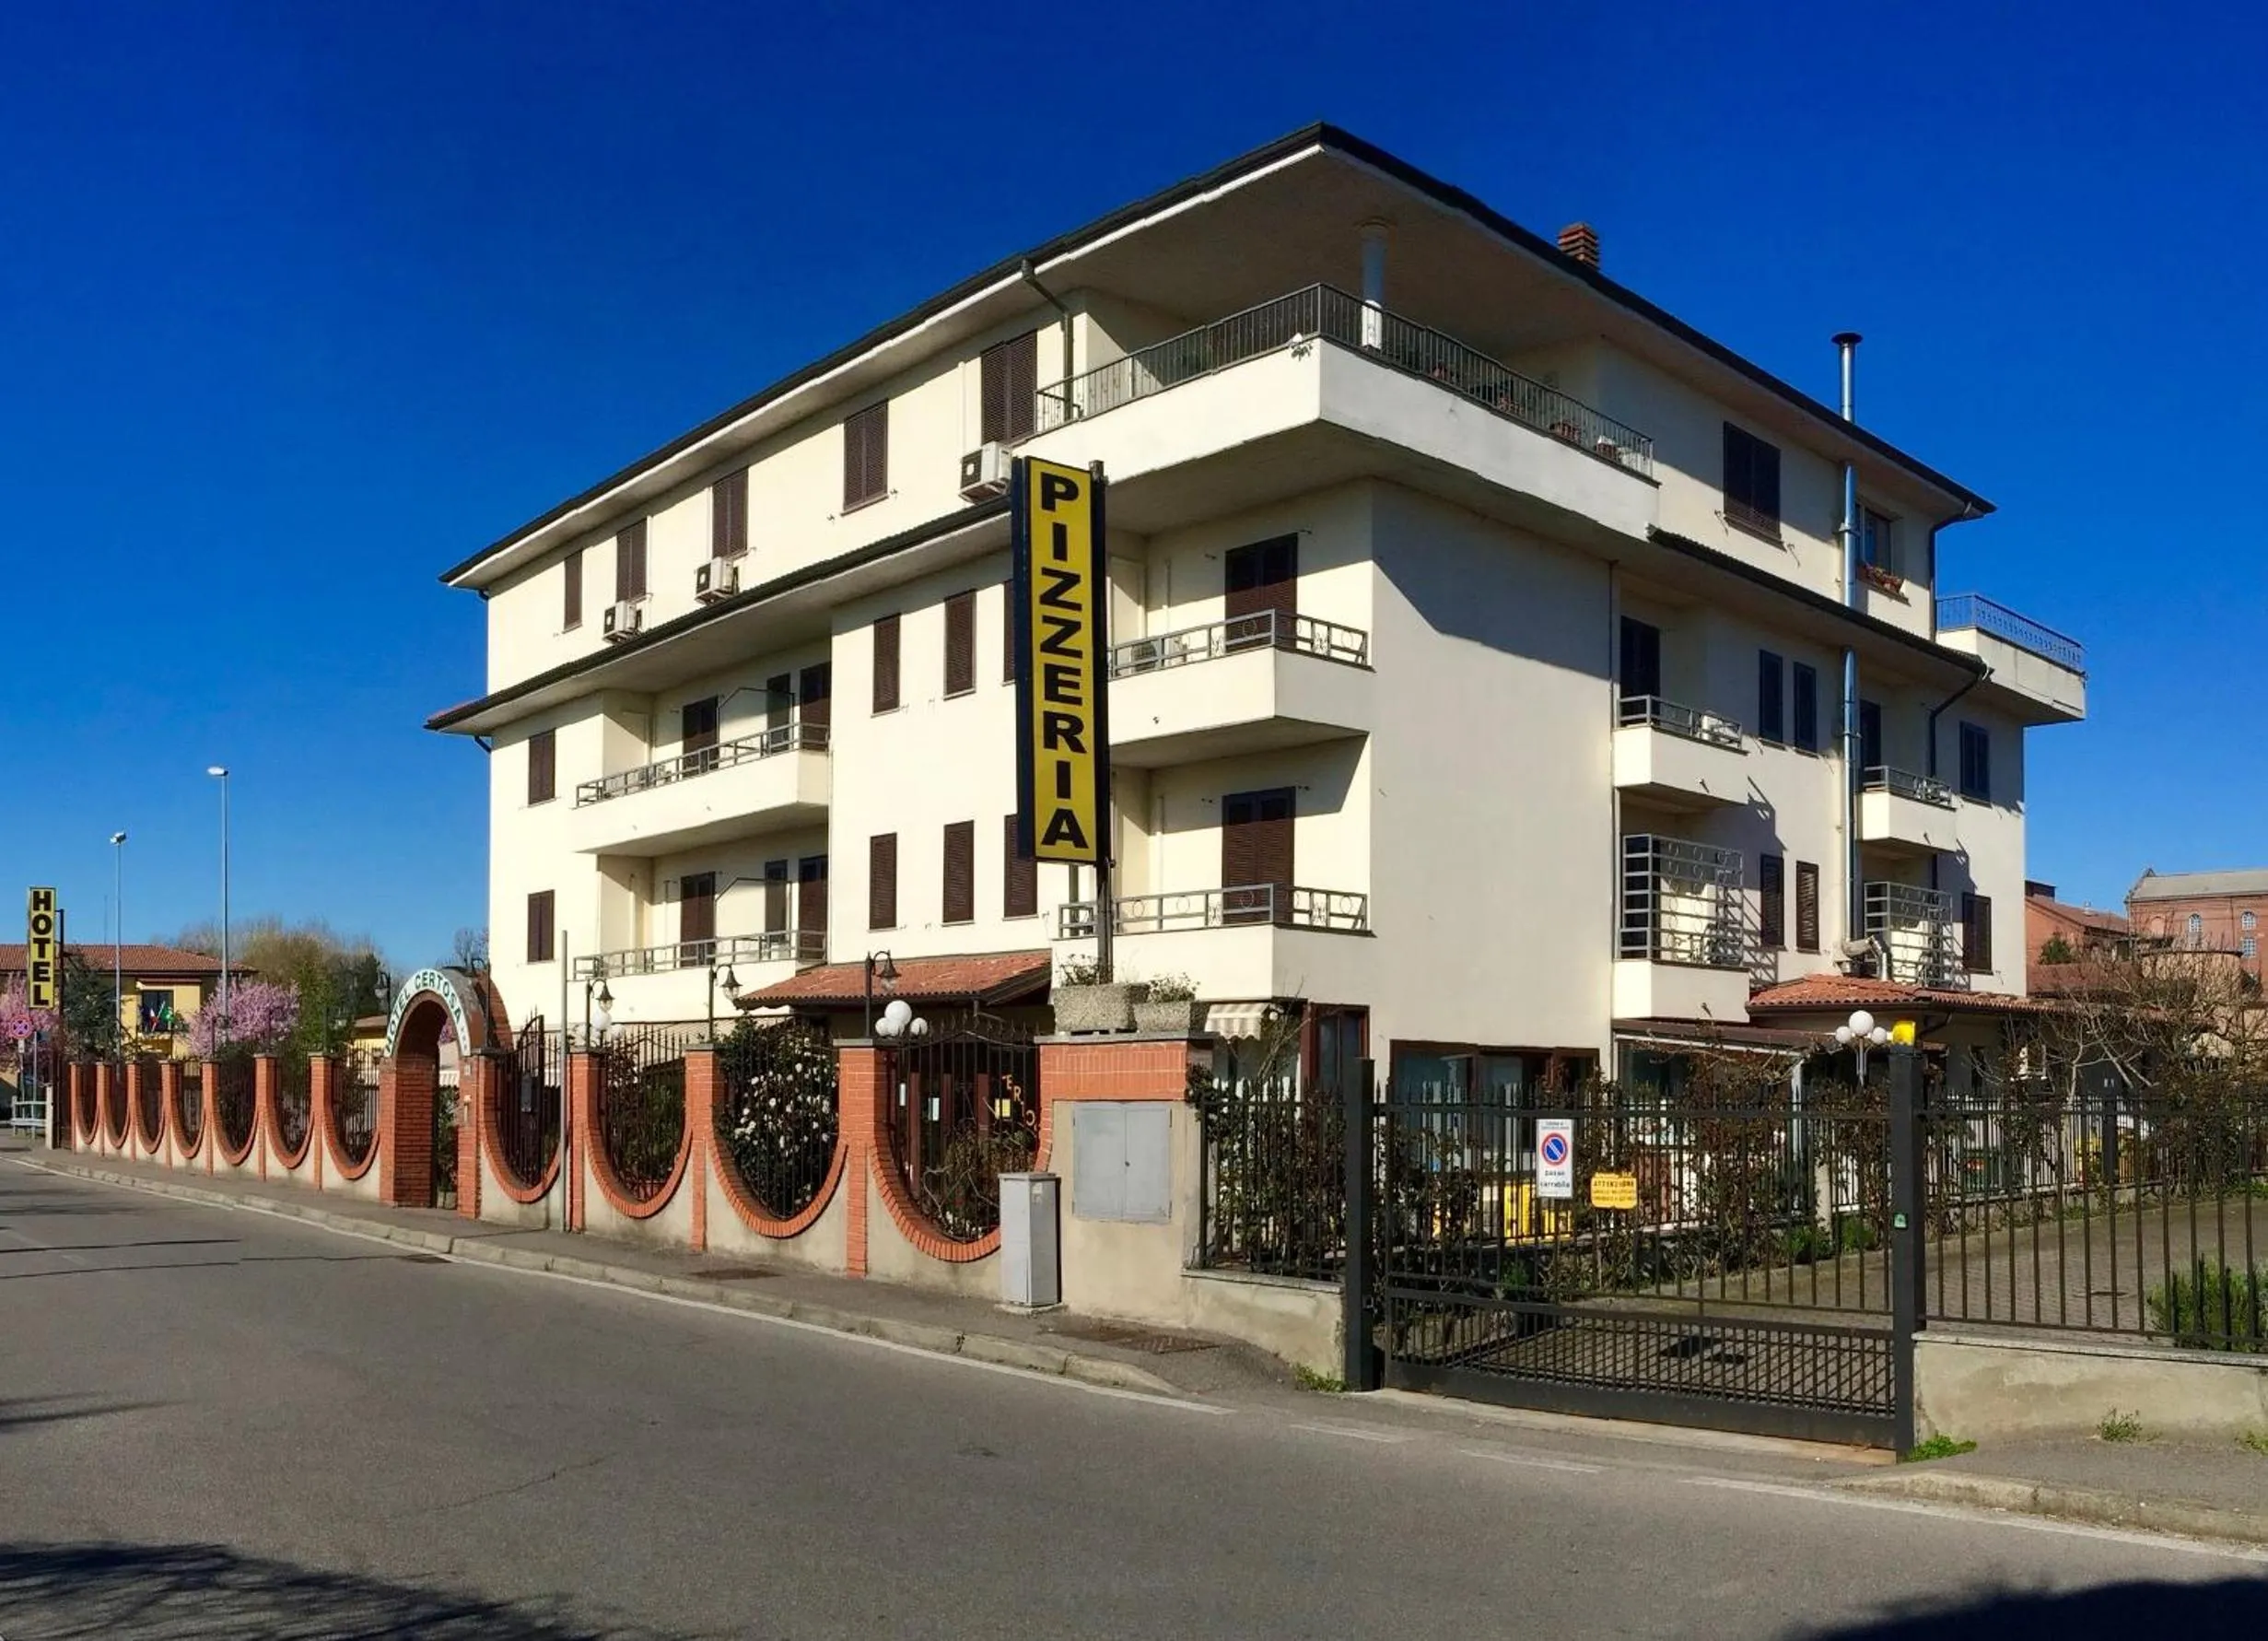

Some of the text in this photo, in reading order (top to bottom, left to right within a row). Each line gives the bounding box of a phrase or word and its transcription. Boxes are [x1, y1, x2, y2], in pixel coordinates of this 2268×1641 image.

[1039, 471, 1089, 850] PIZZERIA
[32, 890, 53, 1005] HOTEL
[385, 971, 462, 1052] HOTEL CERTOSA
